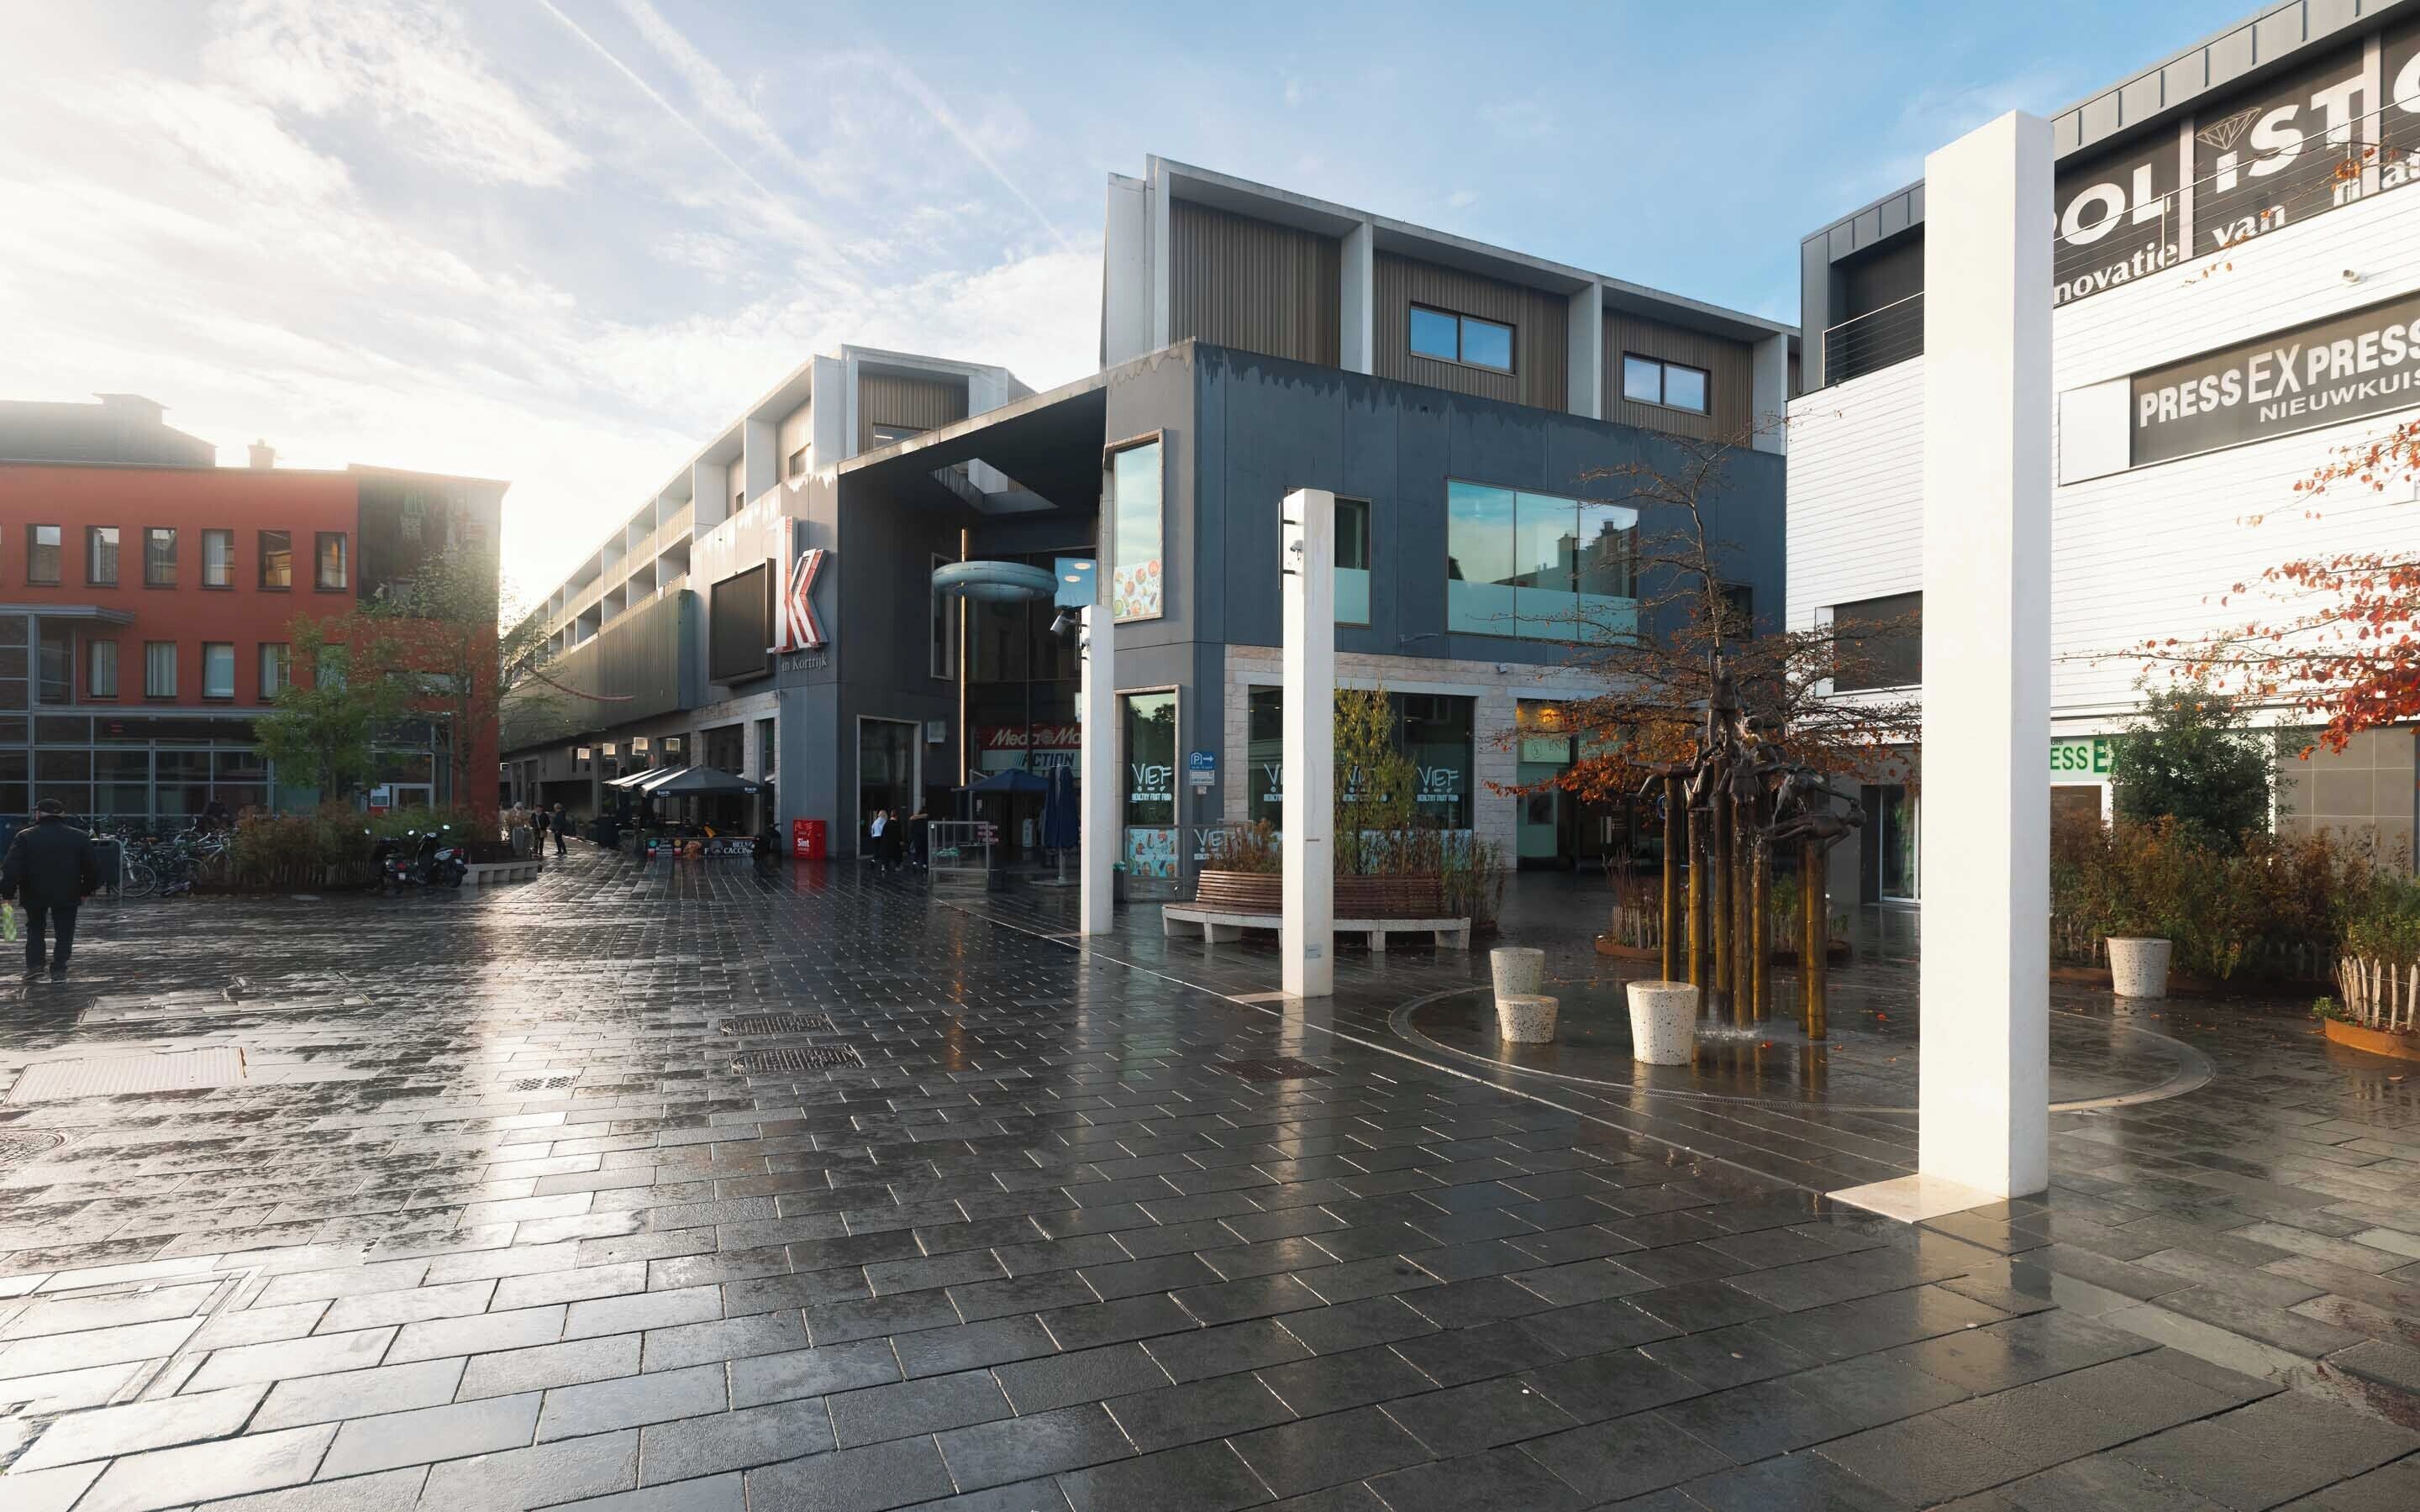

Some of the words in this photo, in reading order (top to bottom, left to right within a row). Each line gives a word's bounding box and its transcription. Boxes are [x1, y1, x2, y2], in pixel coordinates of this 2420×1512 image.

[2212, 205, 2286, 247] van
[2139, 369, 2242, 428] PRESS
[781, 658, 791, 672] in
[792, 652, 827, 670] Kortrijk
